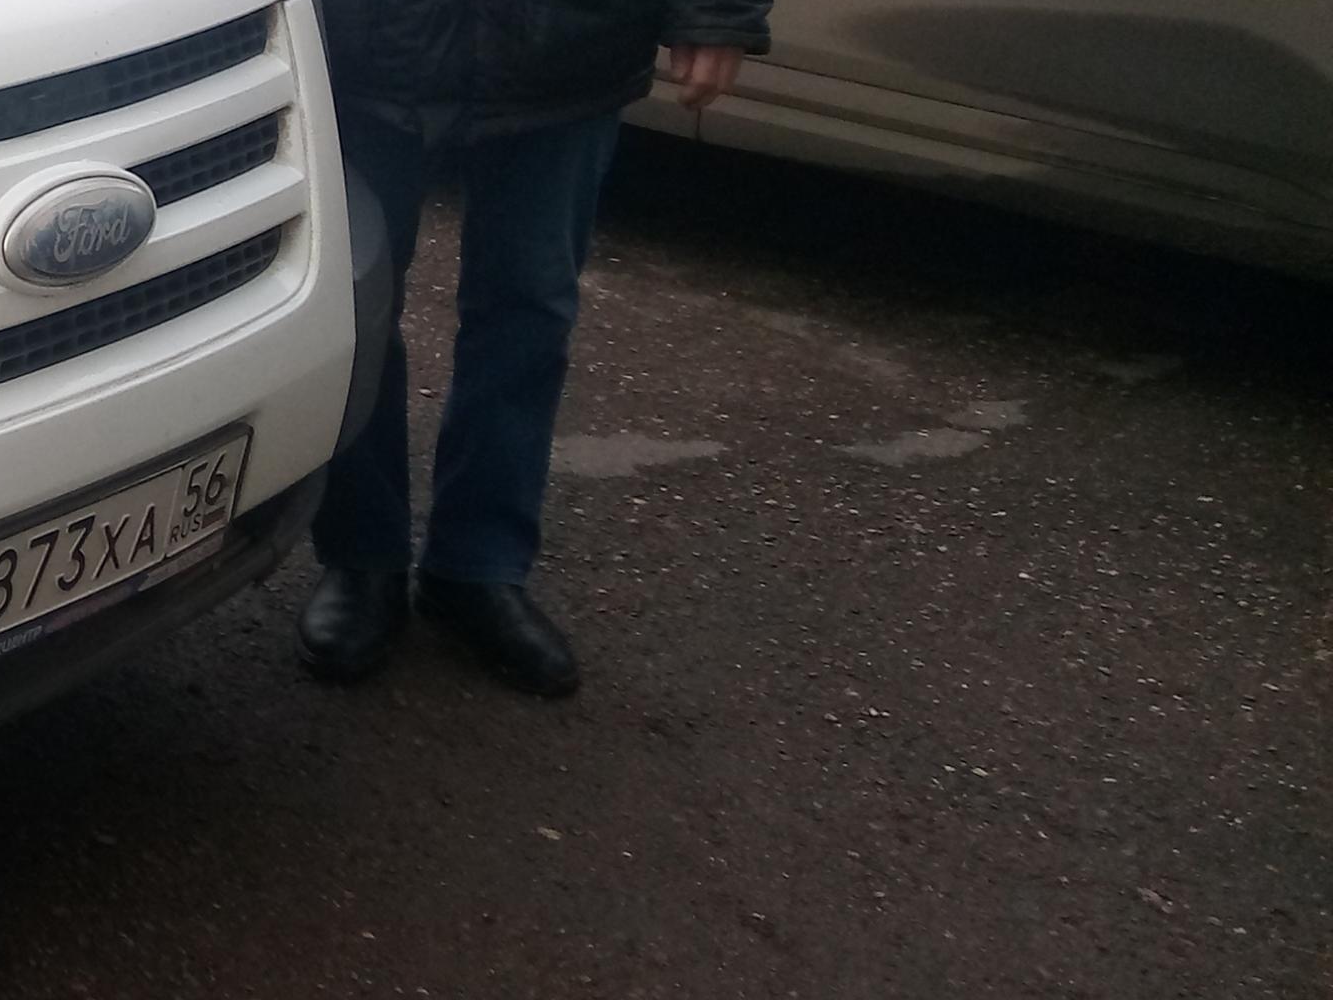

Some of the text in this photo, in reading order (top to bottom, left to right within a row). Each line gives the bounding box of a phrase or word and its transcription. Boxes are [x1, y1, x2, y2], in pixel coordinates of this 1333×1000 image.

[53, 199, 131, 263] Ford
[182, 450, 228, 517] 56
[168, 513, 201, 545] RUS
